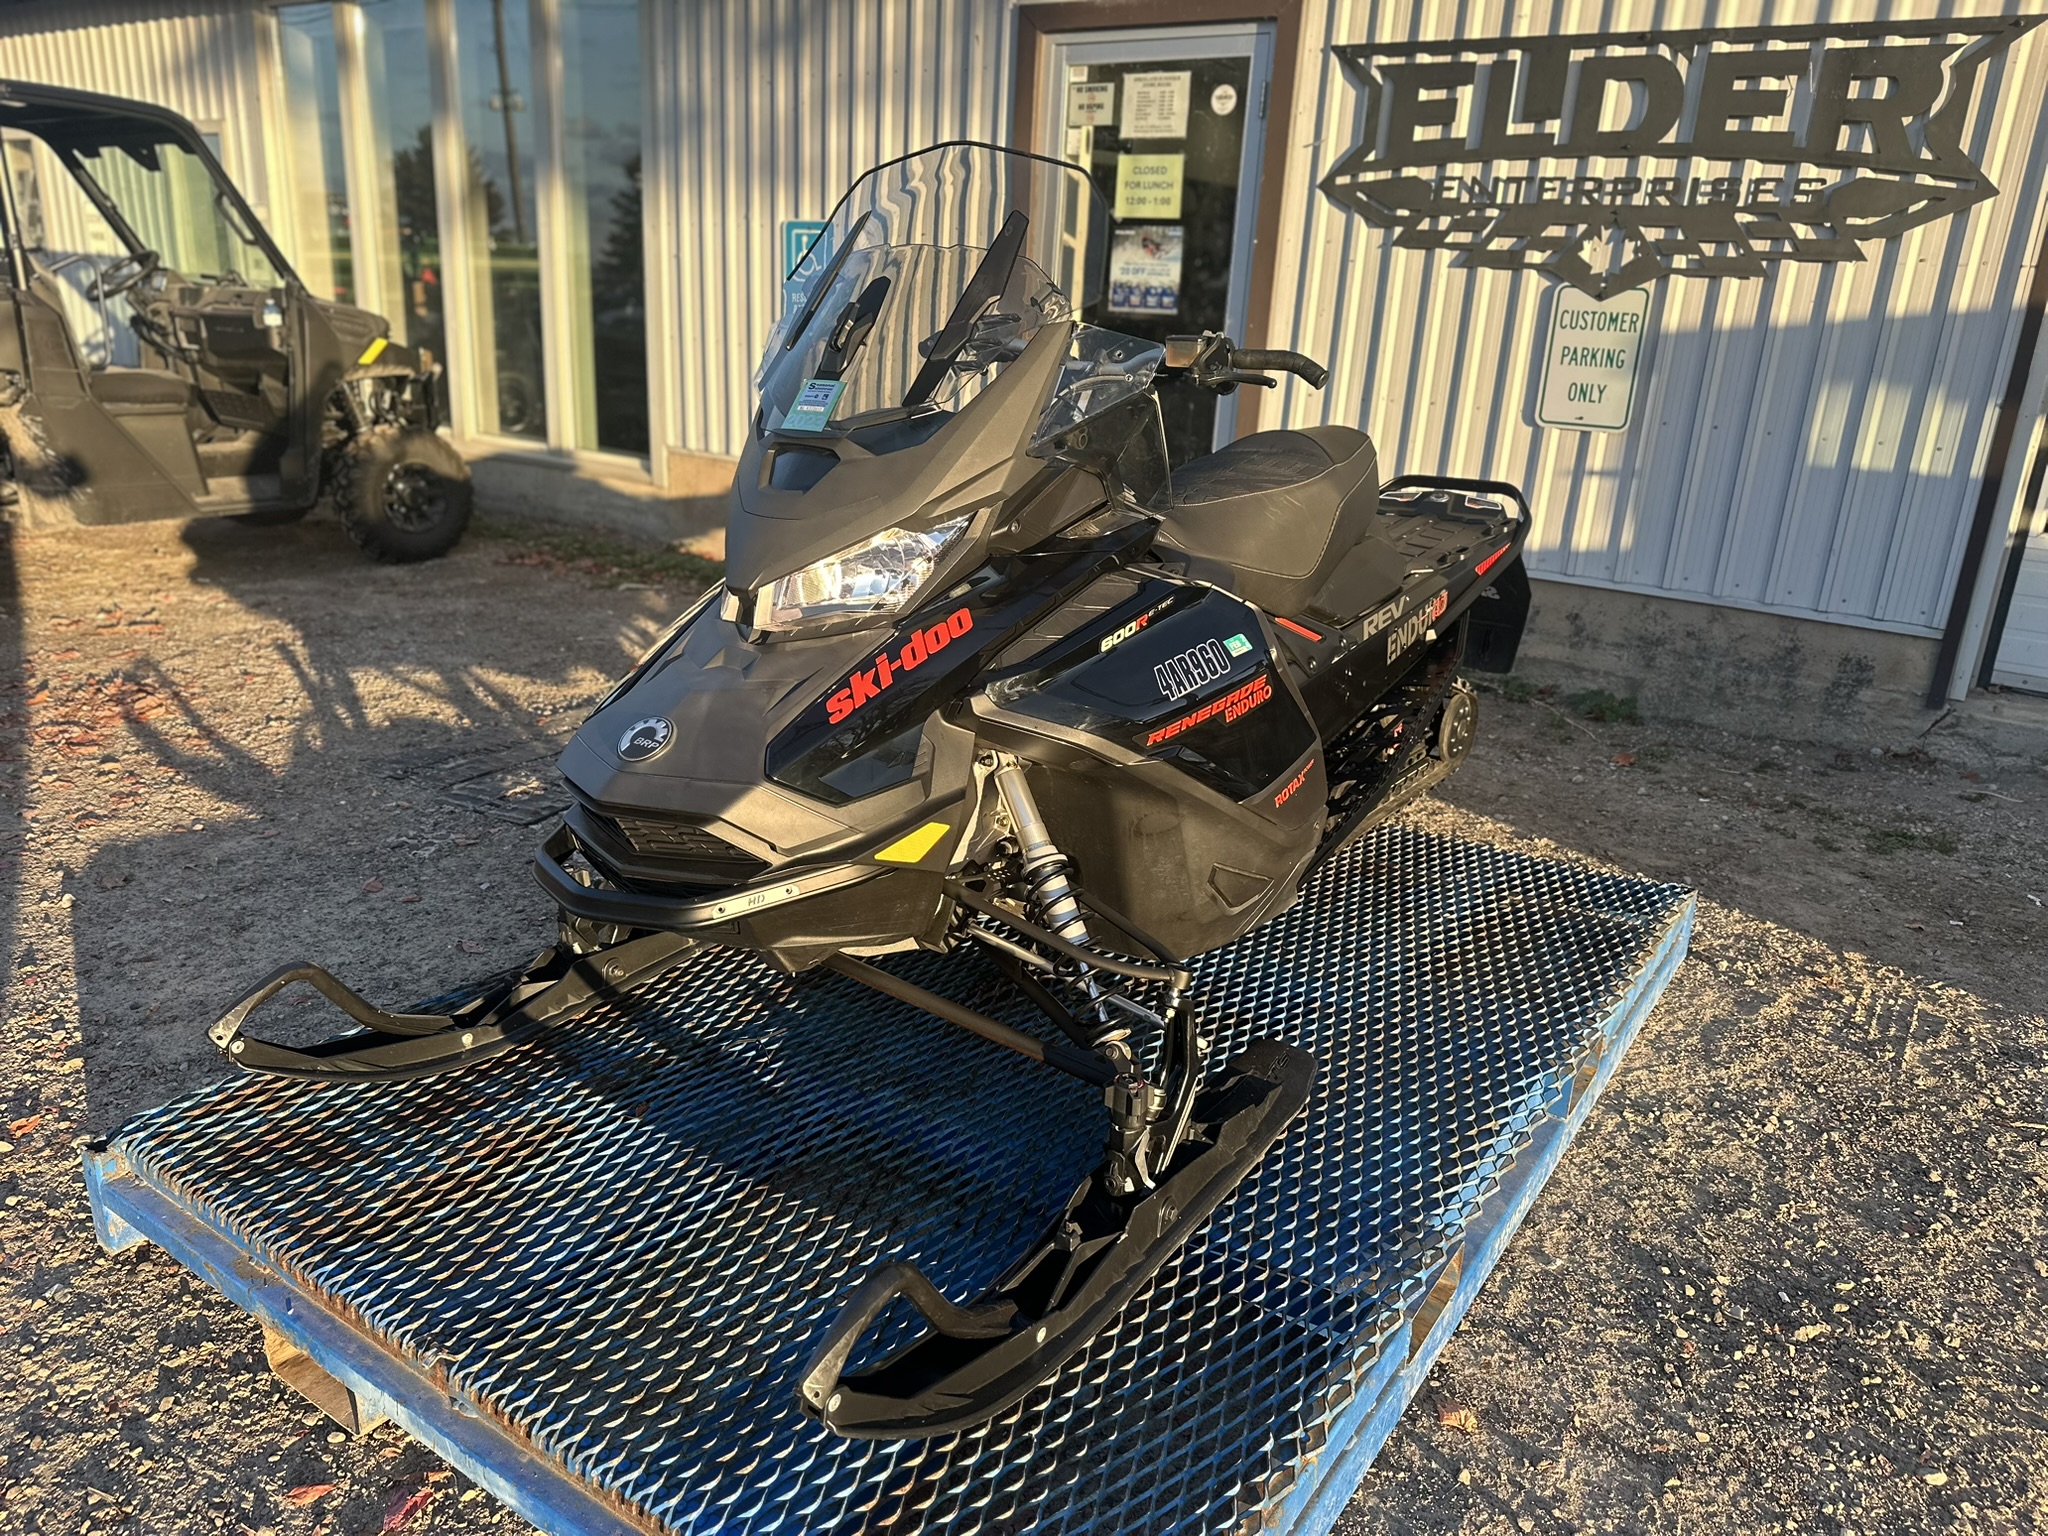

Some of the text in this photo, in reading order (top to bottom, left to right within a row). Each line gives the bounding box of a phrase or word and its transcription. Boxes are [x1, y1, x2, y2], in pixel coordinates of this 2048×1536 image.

[1374, 43, 1968, 162] ELDER
[1124, 181, 1174, 190] FOR LUNCH
[1132, 166, 1168, 175] CLOSED
[1125, 196, 1147, 206] 12:00
[1154, 196, 1172, 206] 1:00
[1433, 175, 1828, 207] ENTERPRISES
[1559, 309, 1640, 333] CUSTOMER
[1560, 346, 1627, 369] PARKING
[1567, 382, 1608, 404] ONLY
[1100, 613, 1149, 653] 600R
[1363, 594, 1406, 640] REV
[825, 607, 975, 725] ski-doo
[1154, 638, 1232, 702] 4AR960
[1146, 673, 1268, 747] RENEGADE
[1224, 685, 1273, 724] ENDURO
[633, 736, 660, 749] BRP
[1274, 770, 1306, 809] ROTAX
